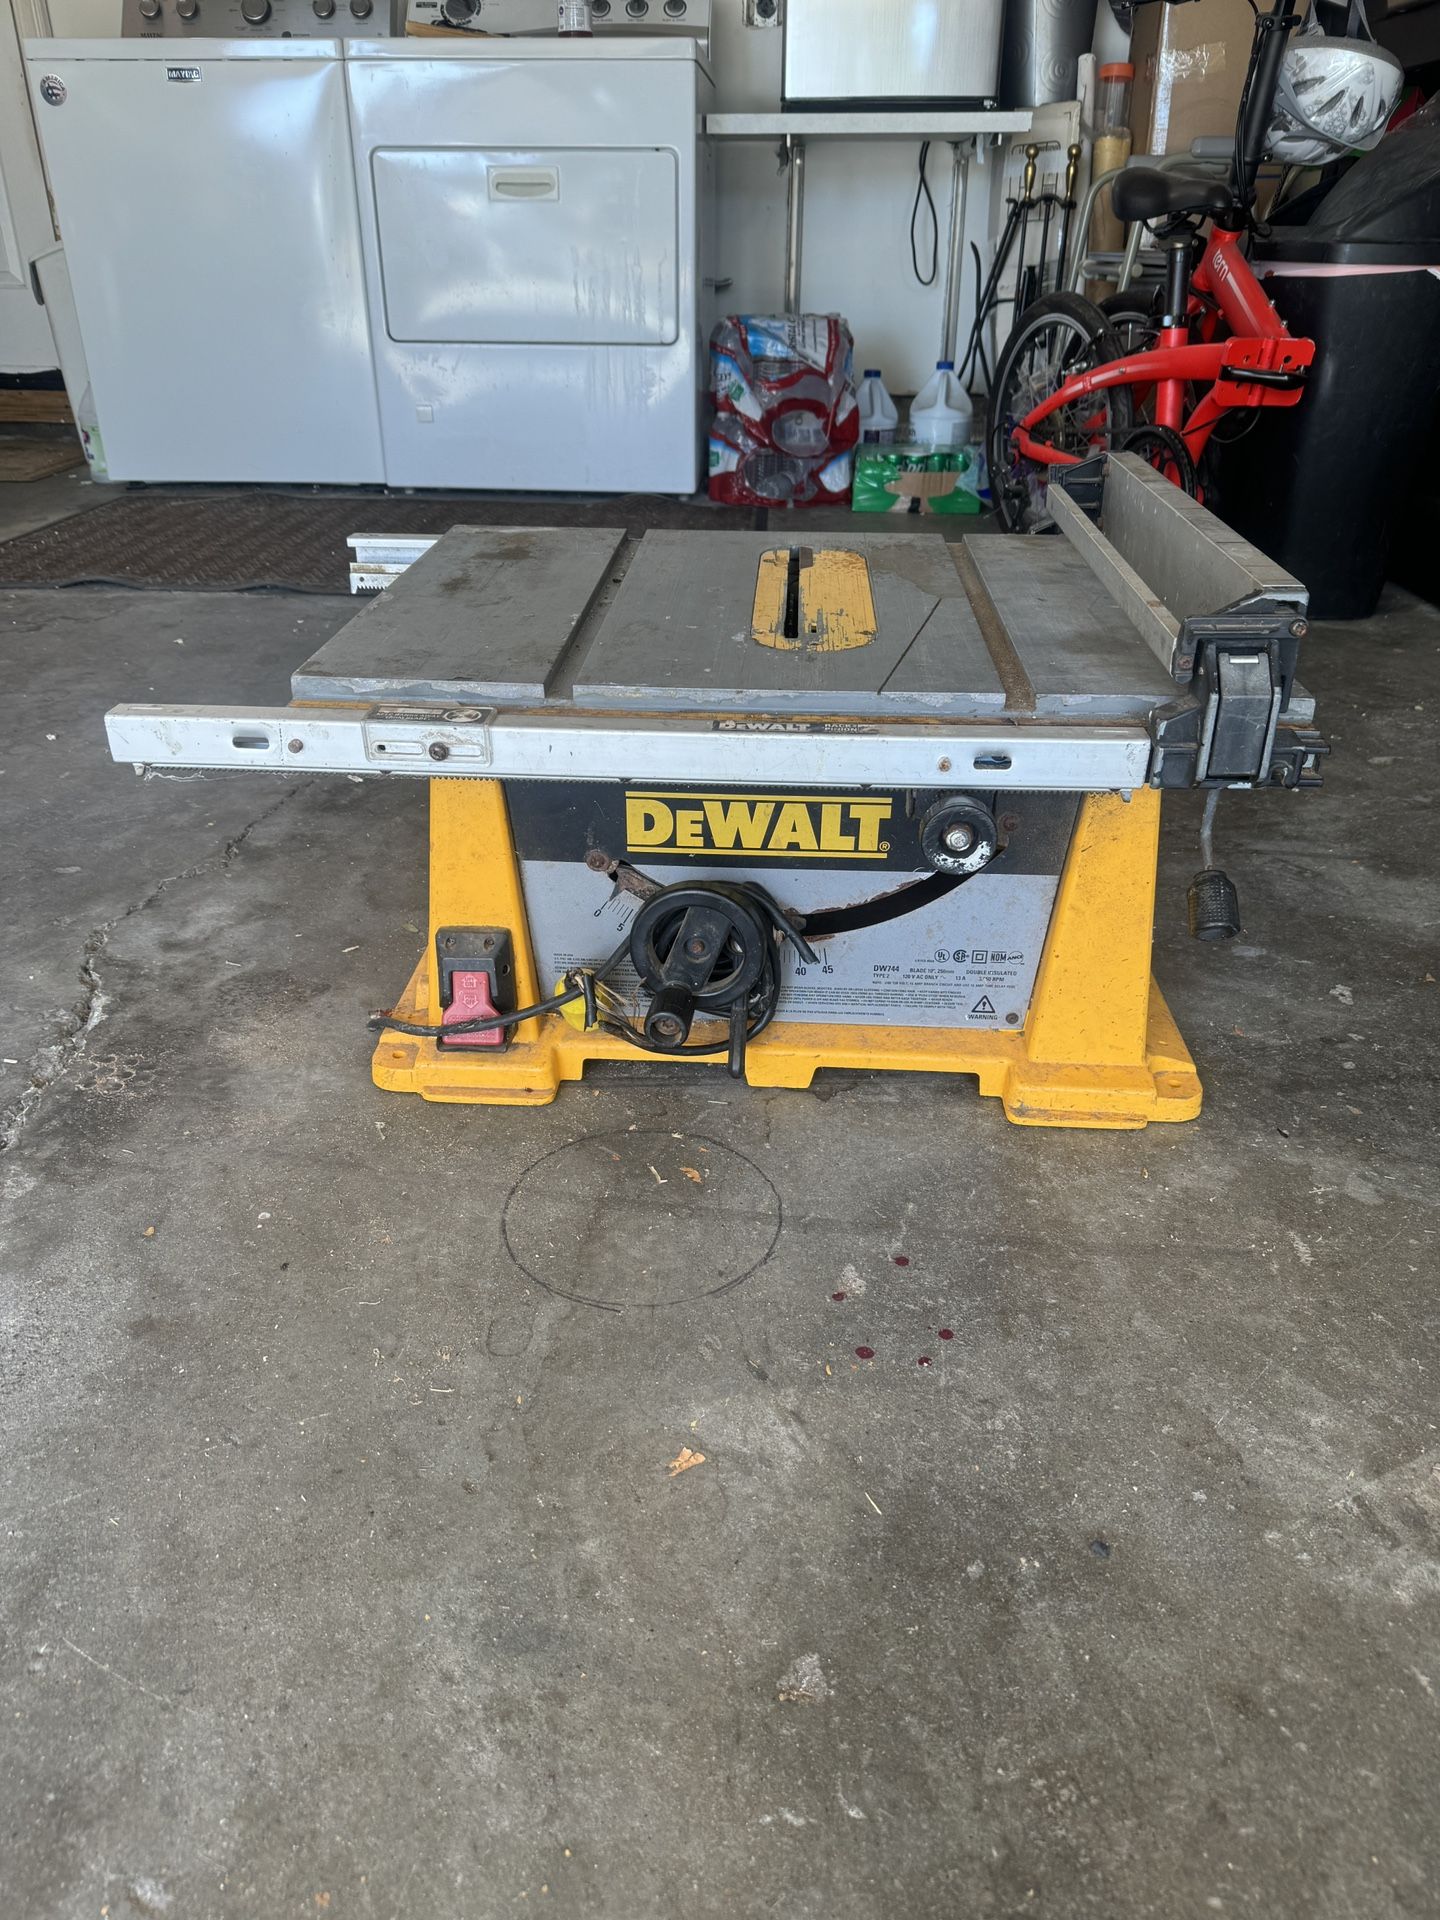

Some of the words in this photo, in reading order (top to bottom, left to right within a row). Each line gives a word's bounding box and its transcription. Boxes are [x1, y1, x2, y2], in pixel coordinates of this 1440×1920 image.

[168, 69, 200, 79] MAYTAG
[1213, 248, 1229, 282] tern
[625, 798, 892, 852] DEWALT
[594, 908, 602, 917] 0
[617, 923, 625, 932] 5
[990, 952, 1007, 962] NOM
[795, 966, 807, 976] 40
[822, 965, 834, 974] 45
[873, 964, 900, 973] DW744
[968, 1013, 998, 1021] WARNING
